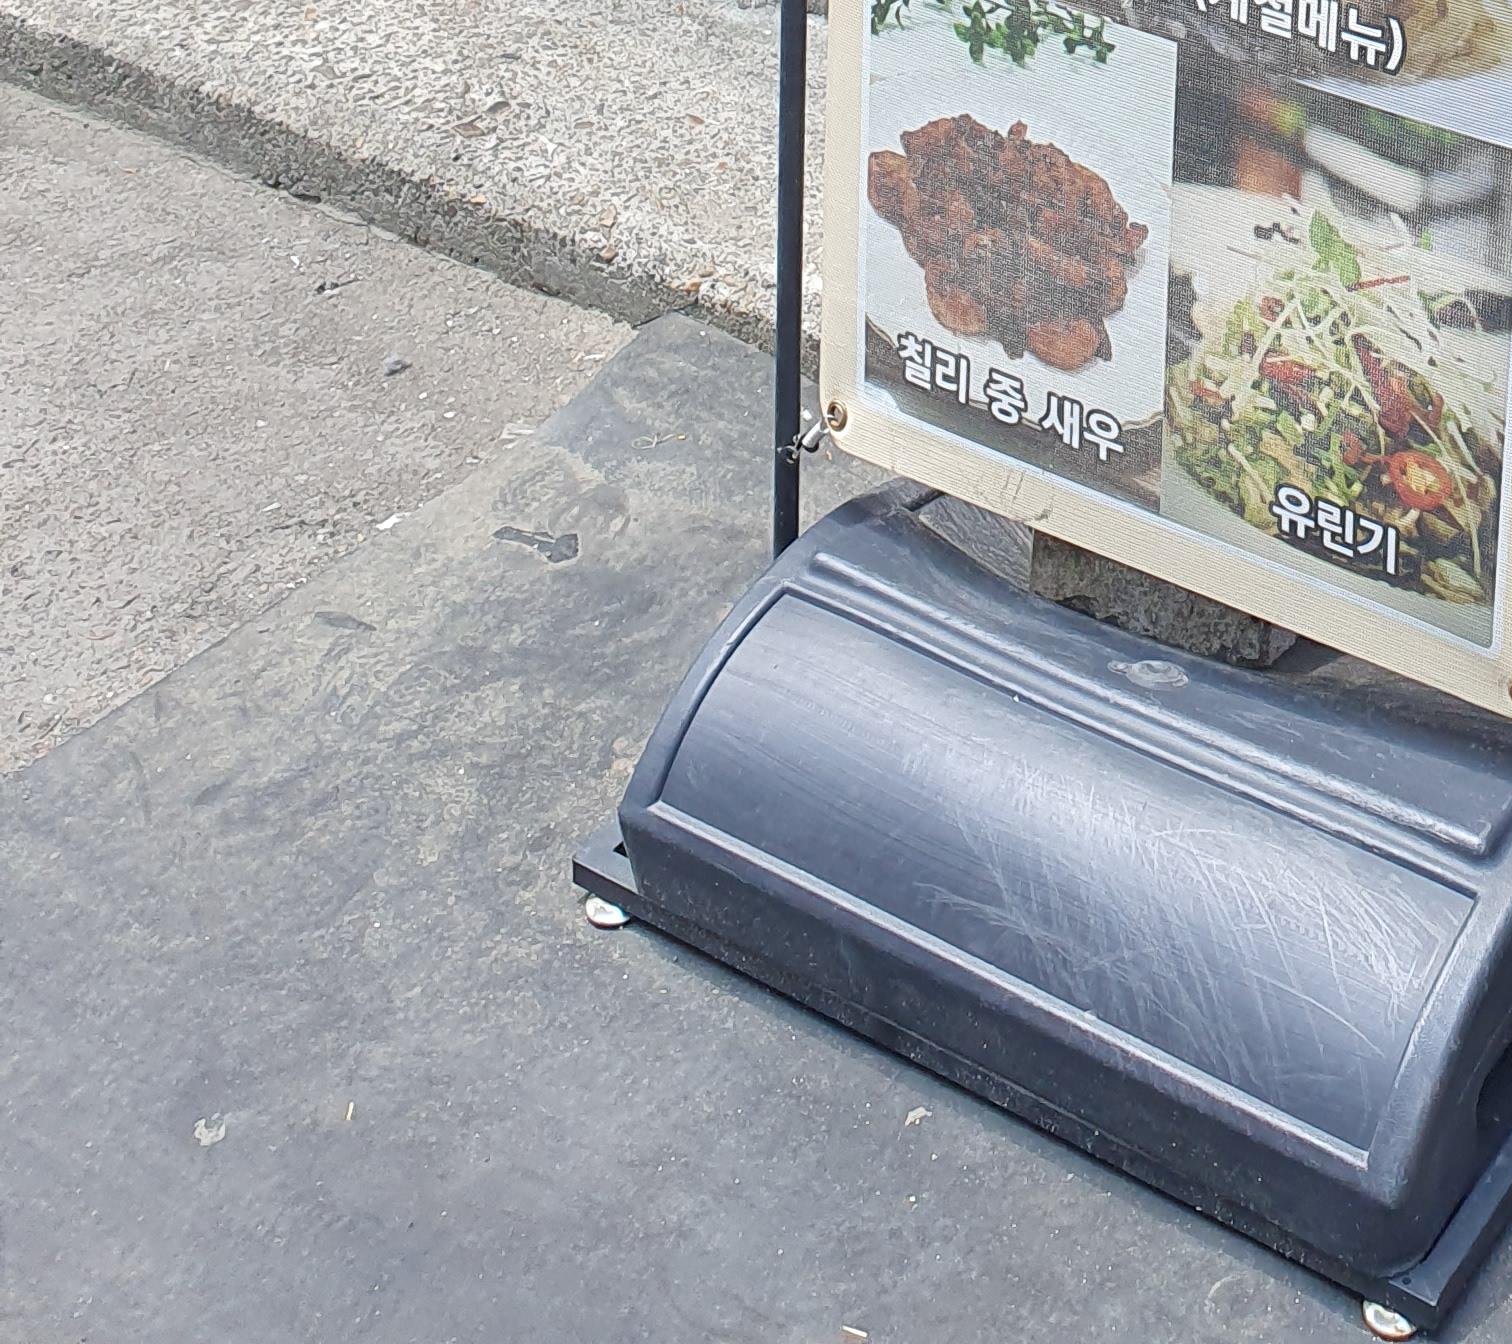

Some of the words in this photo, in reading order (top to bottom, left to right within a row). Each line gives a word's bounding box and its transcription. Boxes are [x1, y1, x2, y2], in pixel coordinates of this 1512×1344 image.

[897, 333, 970, 404] 칠리
[984, 370, 1026, 425] 중
[1041, 394, 1125, 462] 새우
[1271, 485, 1397, 576] 유린기
